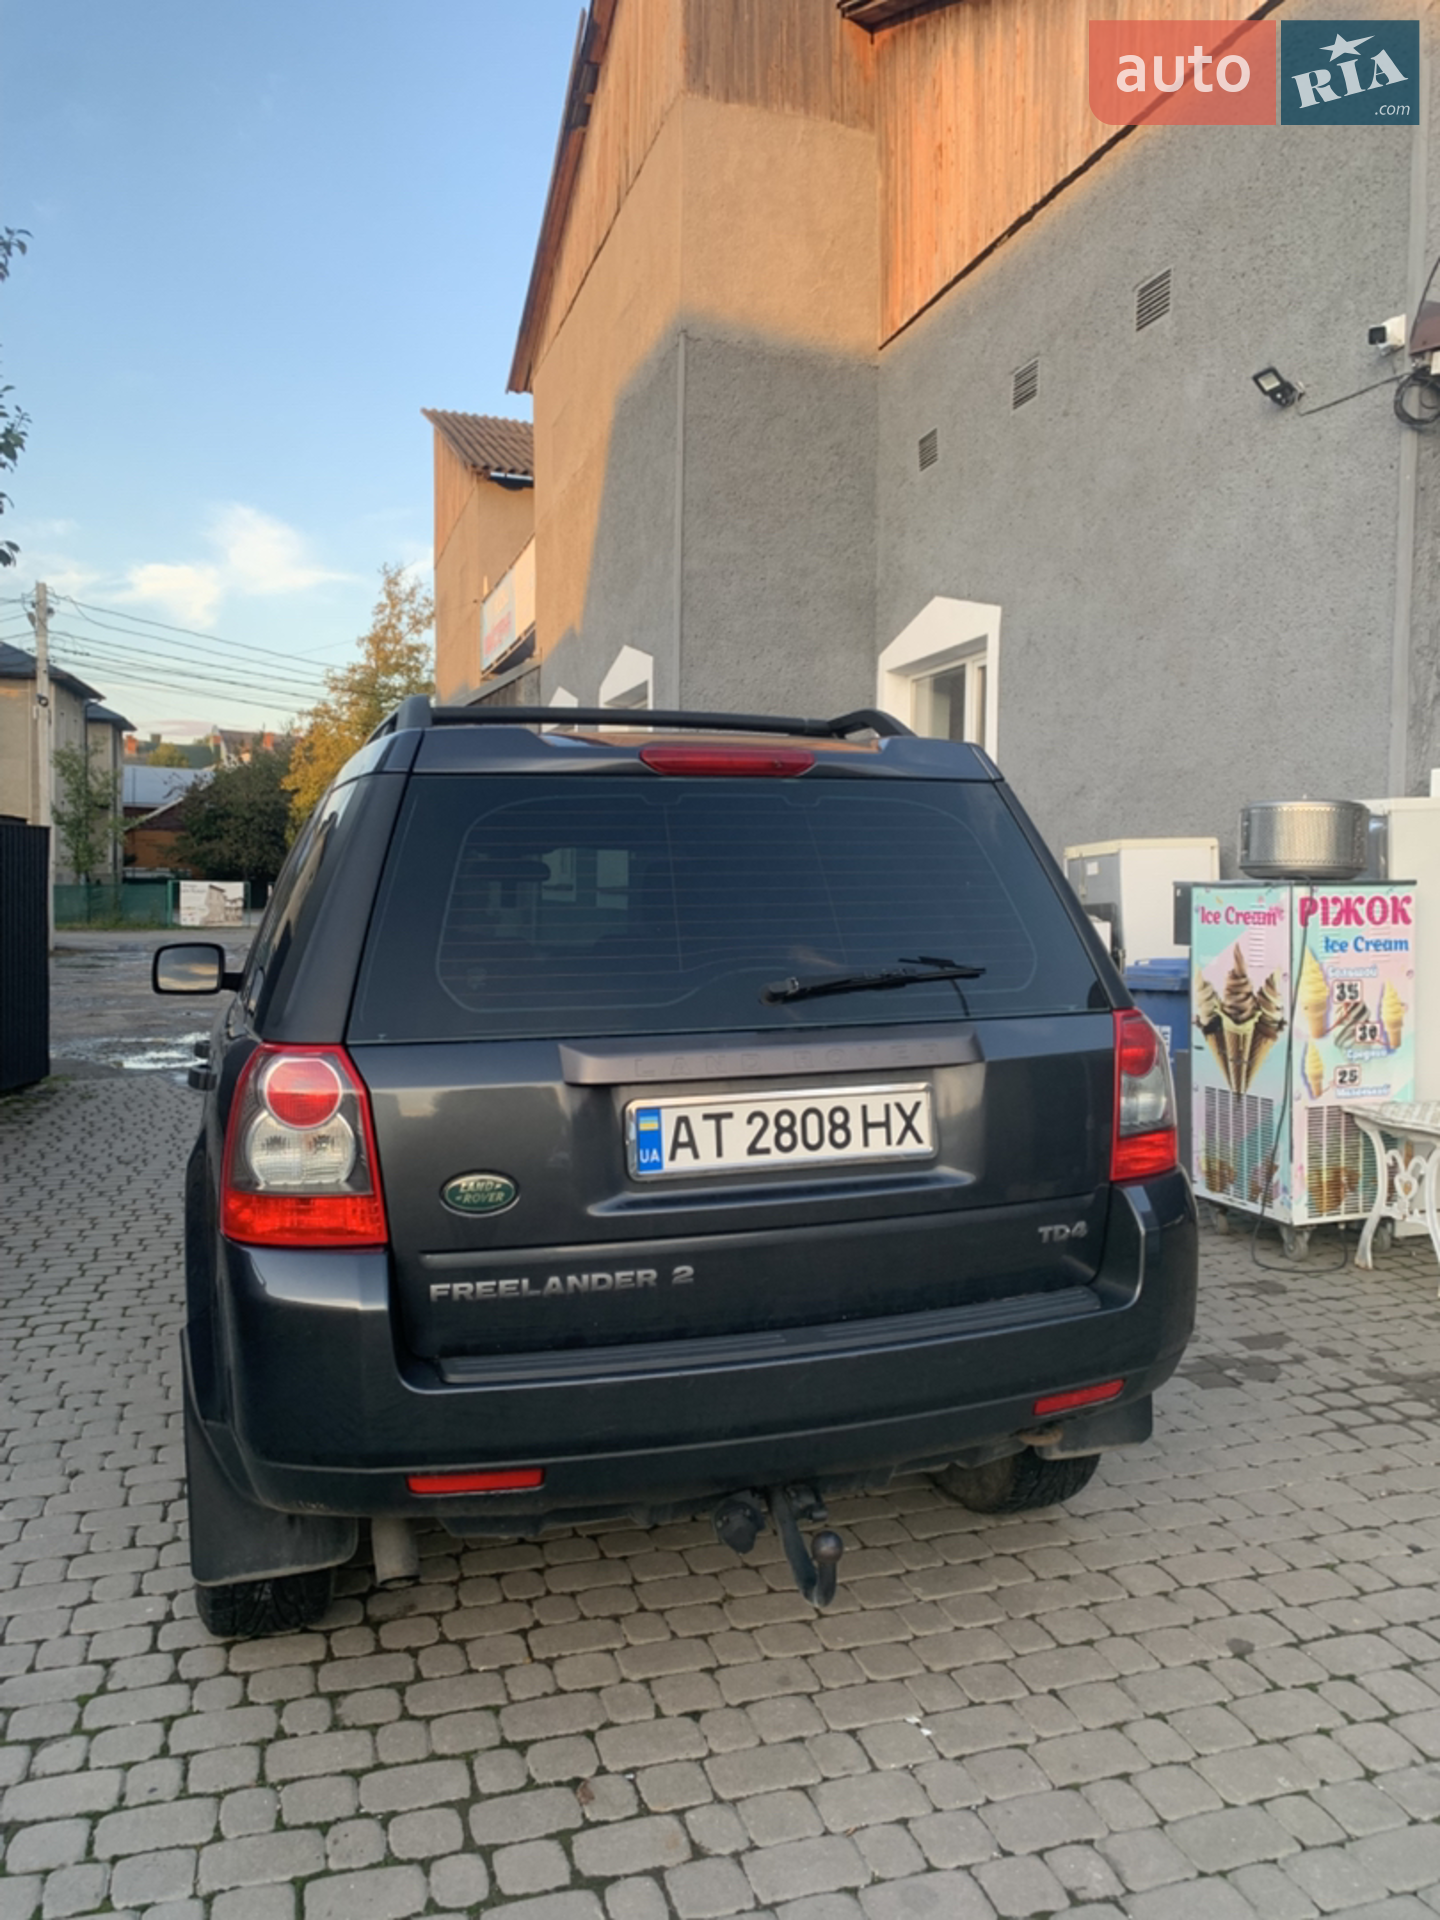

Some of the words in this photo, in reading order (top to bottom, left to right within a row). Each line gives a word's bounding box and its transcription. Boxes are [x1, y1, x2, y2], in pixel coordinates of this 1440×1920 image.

[1201, 906, 1221, 925] Ice
[1224, 906, 1278, 926] Cream
[1299, 895, 1413, 927] РІЖОК
[1324, 936, 1348, 953] Ice
[1353, 936, 1410, 953] Cream
[1335, 982, 1360, 1002] 35
[634, 1053, 761, 1079] LAND
[793, 1043, 943, 1070] ROVER
[1338, 1069, 1358, 1084] 25
[668, 1112, 734, 1162] AT
[745, 1105, 852, 1157] 2808
[861, 1101, 924, 1149] HX
[639, 1149, 661, 1164] UA
[459, 1181, 495, 1192] LAND
[462, 1191, 506, 1204] ROVER
[1038, 1220, 1088, 1244] TD4
[429, 1268, 658, 1303] FREELANDER
[671, 1265, 695, 1284] 2
